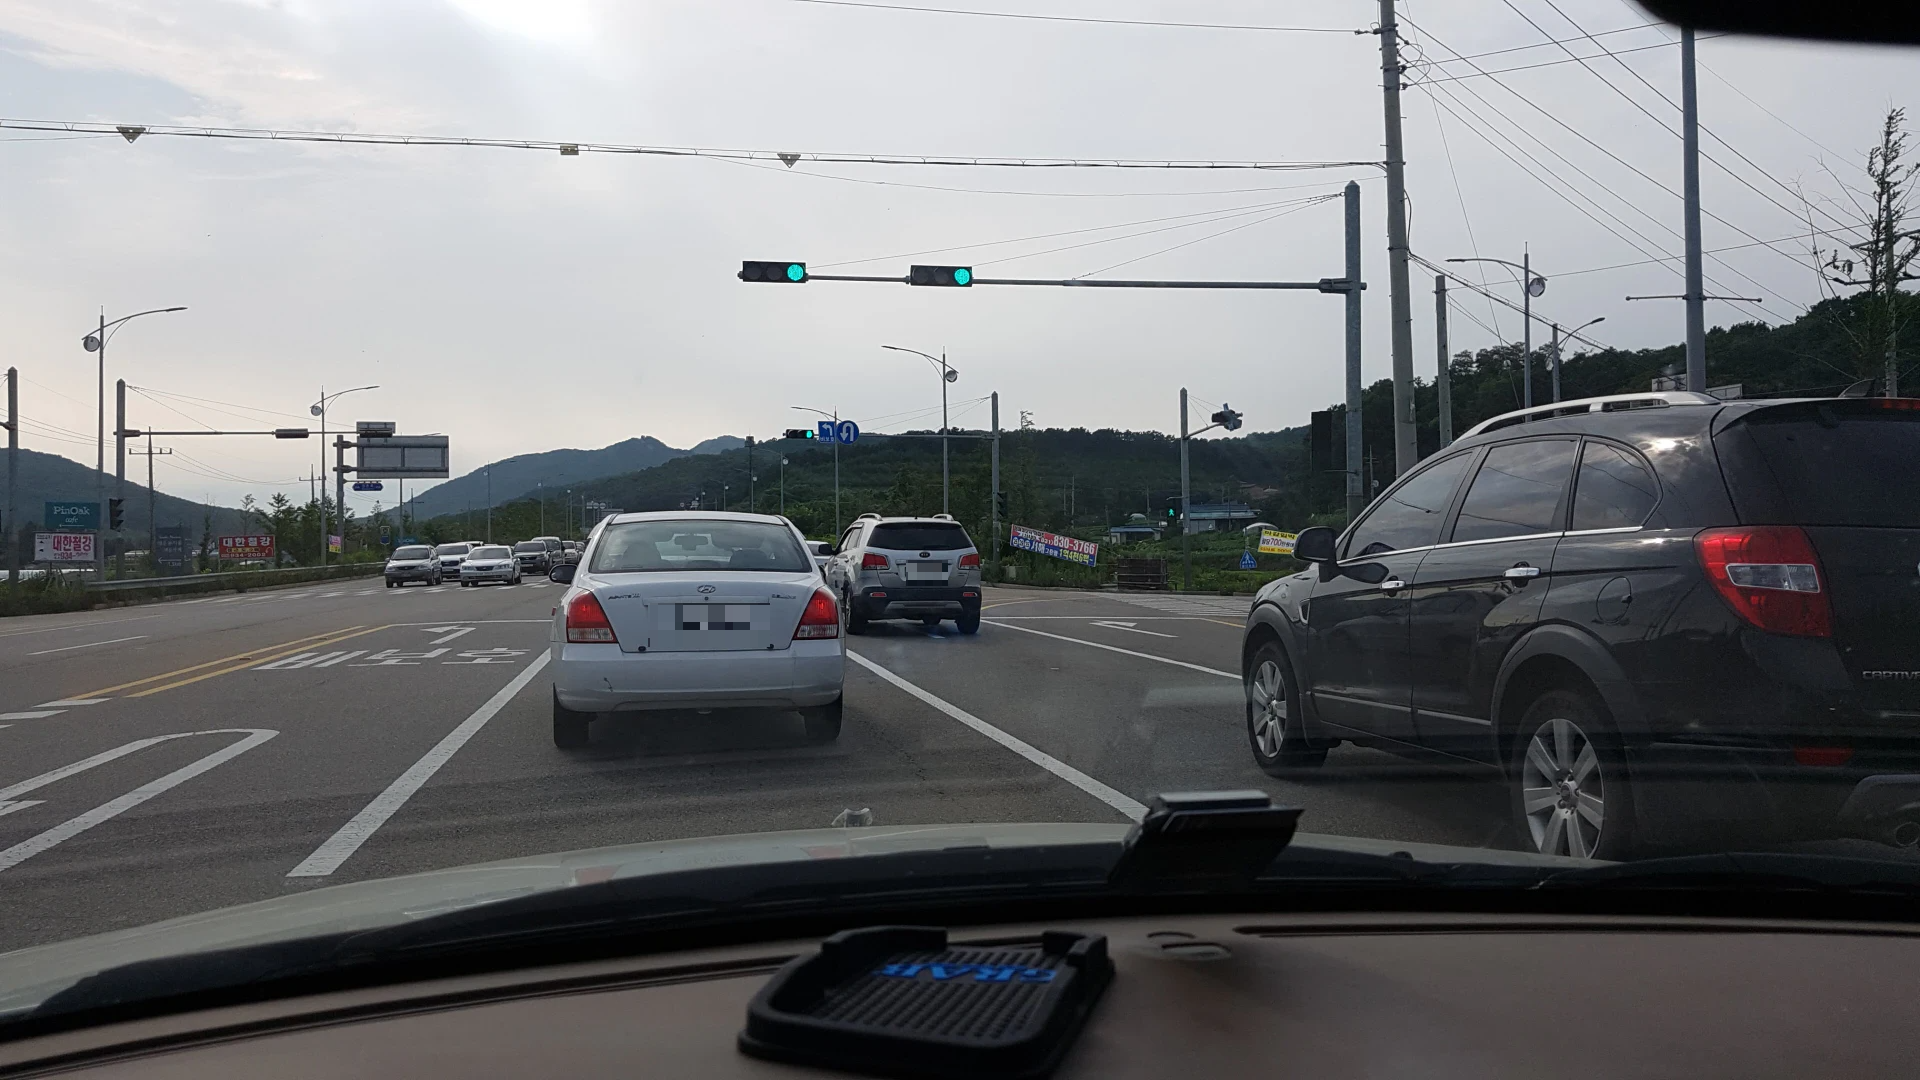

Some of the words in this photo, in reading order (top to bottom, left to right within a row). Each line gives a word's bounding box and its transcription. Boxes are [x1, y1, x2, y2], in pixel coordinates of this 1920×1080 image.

[53, 505, 90, 515] PinOak
[65, 515, 79, 524] cafe
[52, 535, 92, 552] 대한철강
[222, 537, 271, 547] 대한철강
[252, 646, 531, 671] 비보호
